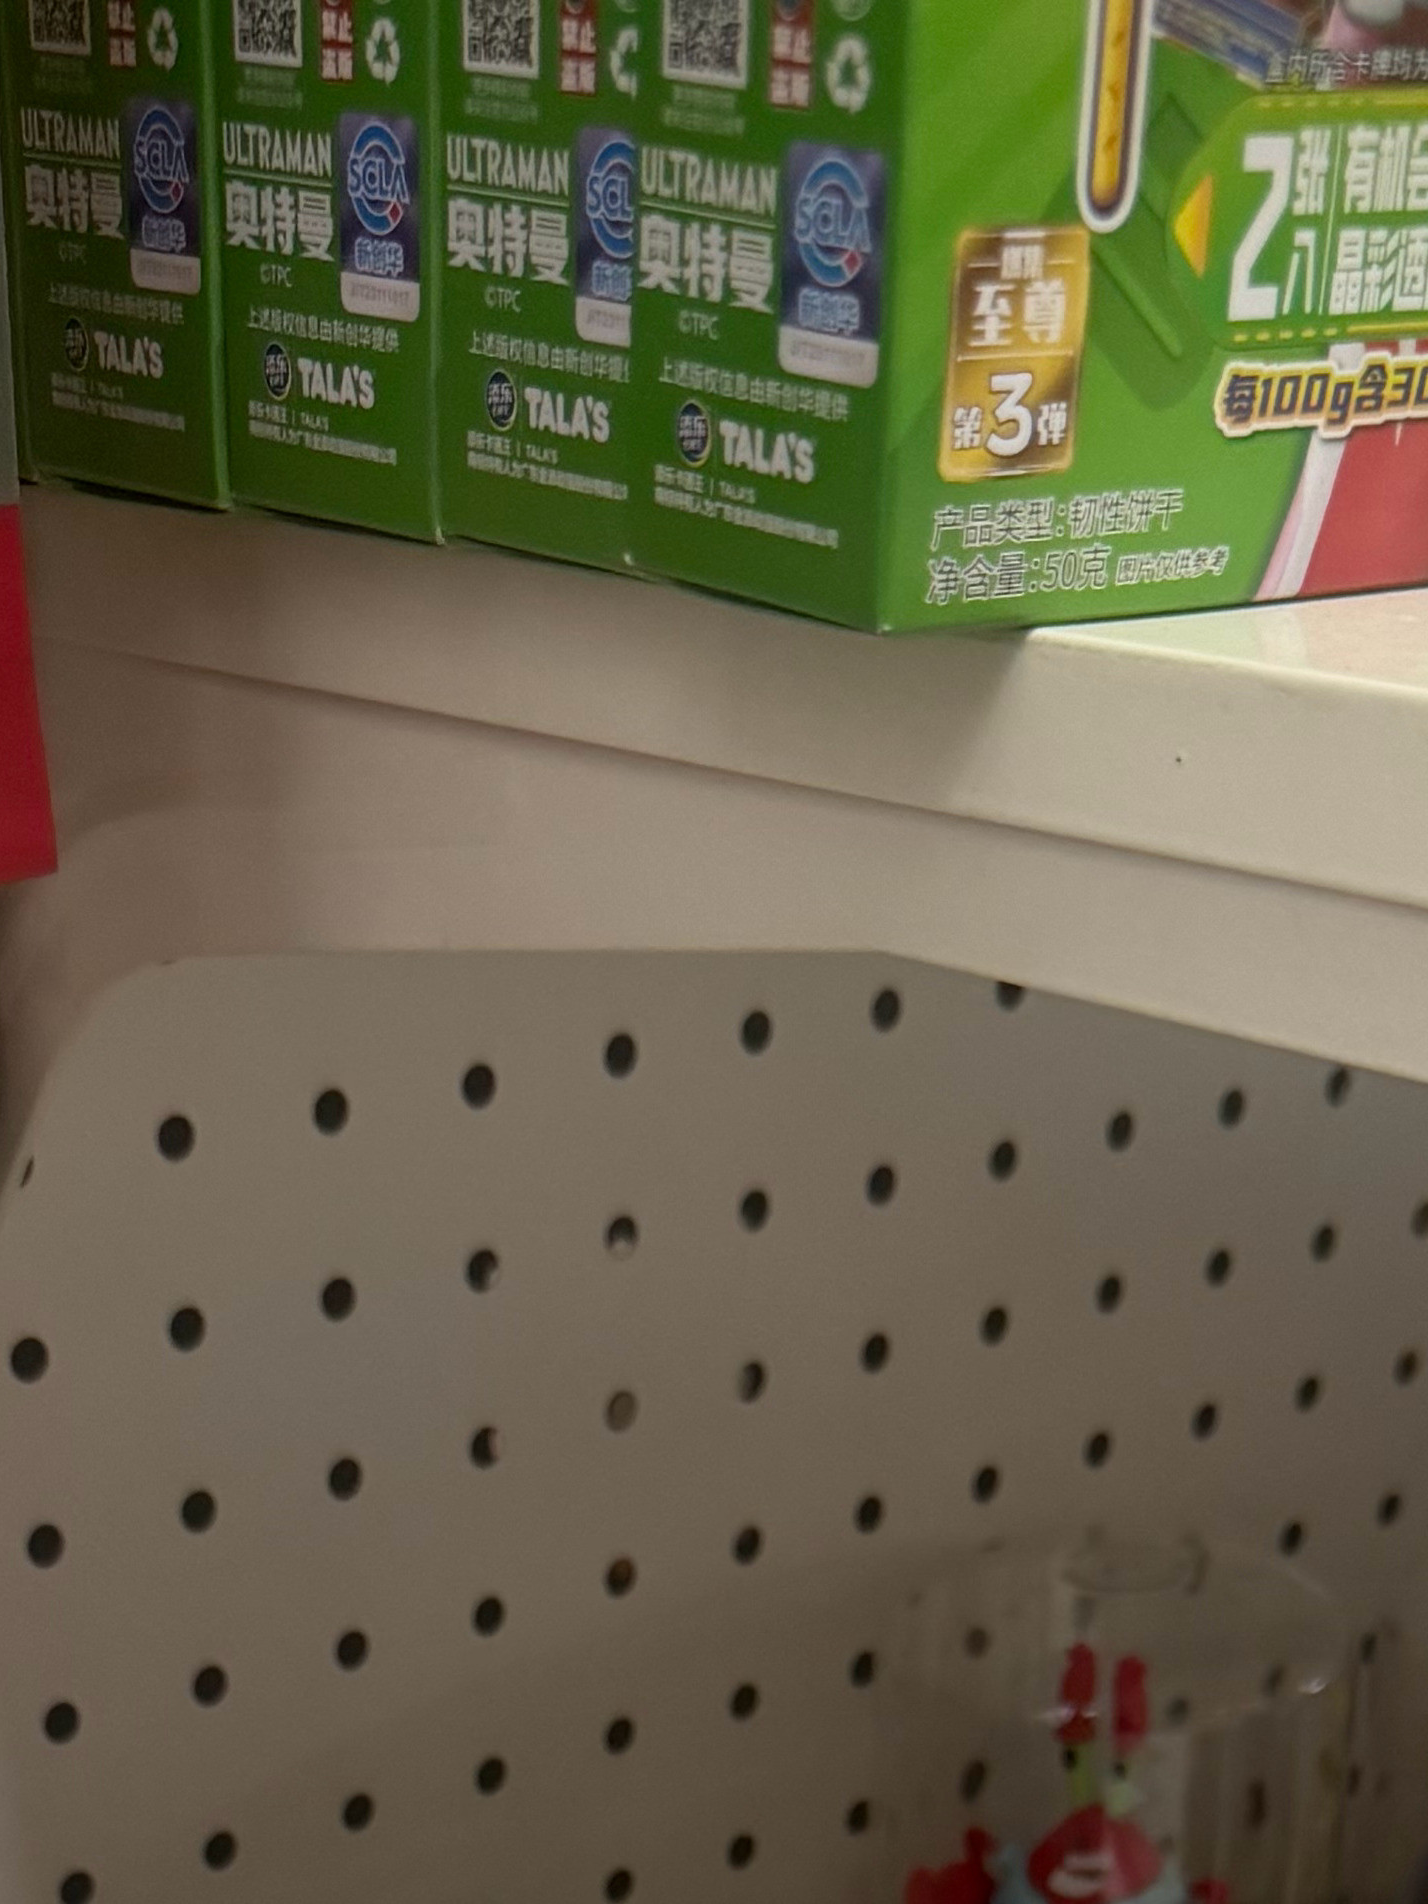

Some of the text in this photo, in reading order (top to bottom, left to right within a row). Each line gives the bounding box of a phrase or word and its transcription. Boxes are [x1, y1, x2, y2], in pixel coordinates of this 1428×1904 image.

[21, 107, 121, 161] ULTRAMAN
[223, 121, 332, 178] ULTRAMAN
[447, 133, 570, 197] ULTRAMAN
[25, 164, 124, 240] 奥特曼
[640, 146, 778, 217] ULTRAMAN
[226, 180, 335, 262] 奥特曼
[447, 195, 570, 286] 奥特曼
[638, 212, 775, 314] 奥特曼
[967, 277, 1066, 347] 至尊
[93, 330, 164, 379] TALA'S
[297, 357, 375, 409] TALA'S
[524, 386, 611, 443] TALA'S
[953, 371, 1068, 458] 第3弹
[719, 418, 816, 484] TALA'S
[925, 542, 1231, 606] 净含量:50克 图片仅供参考
